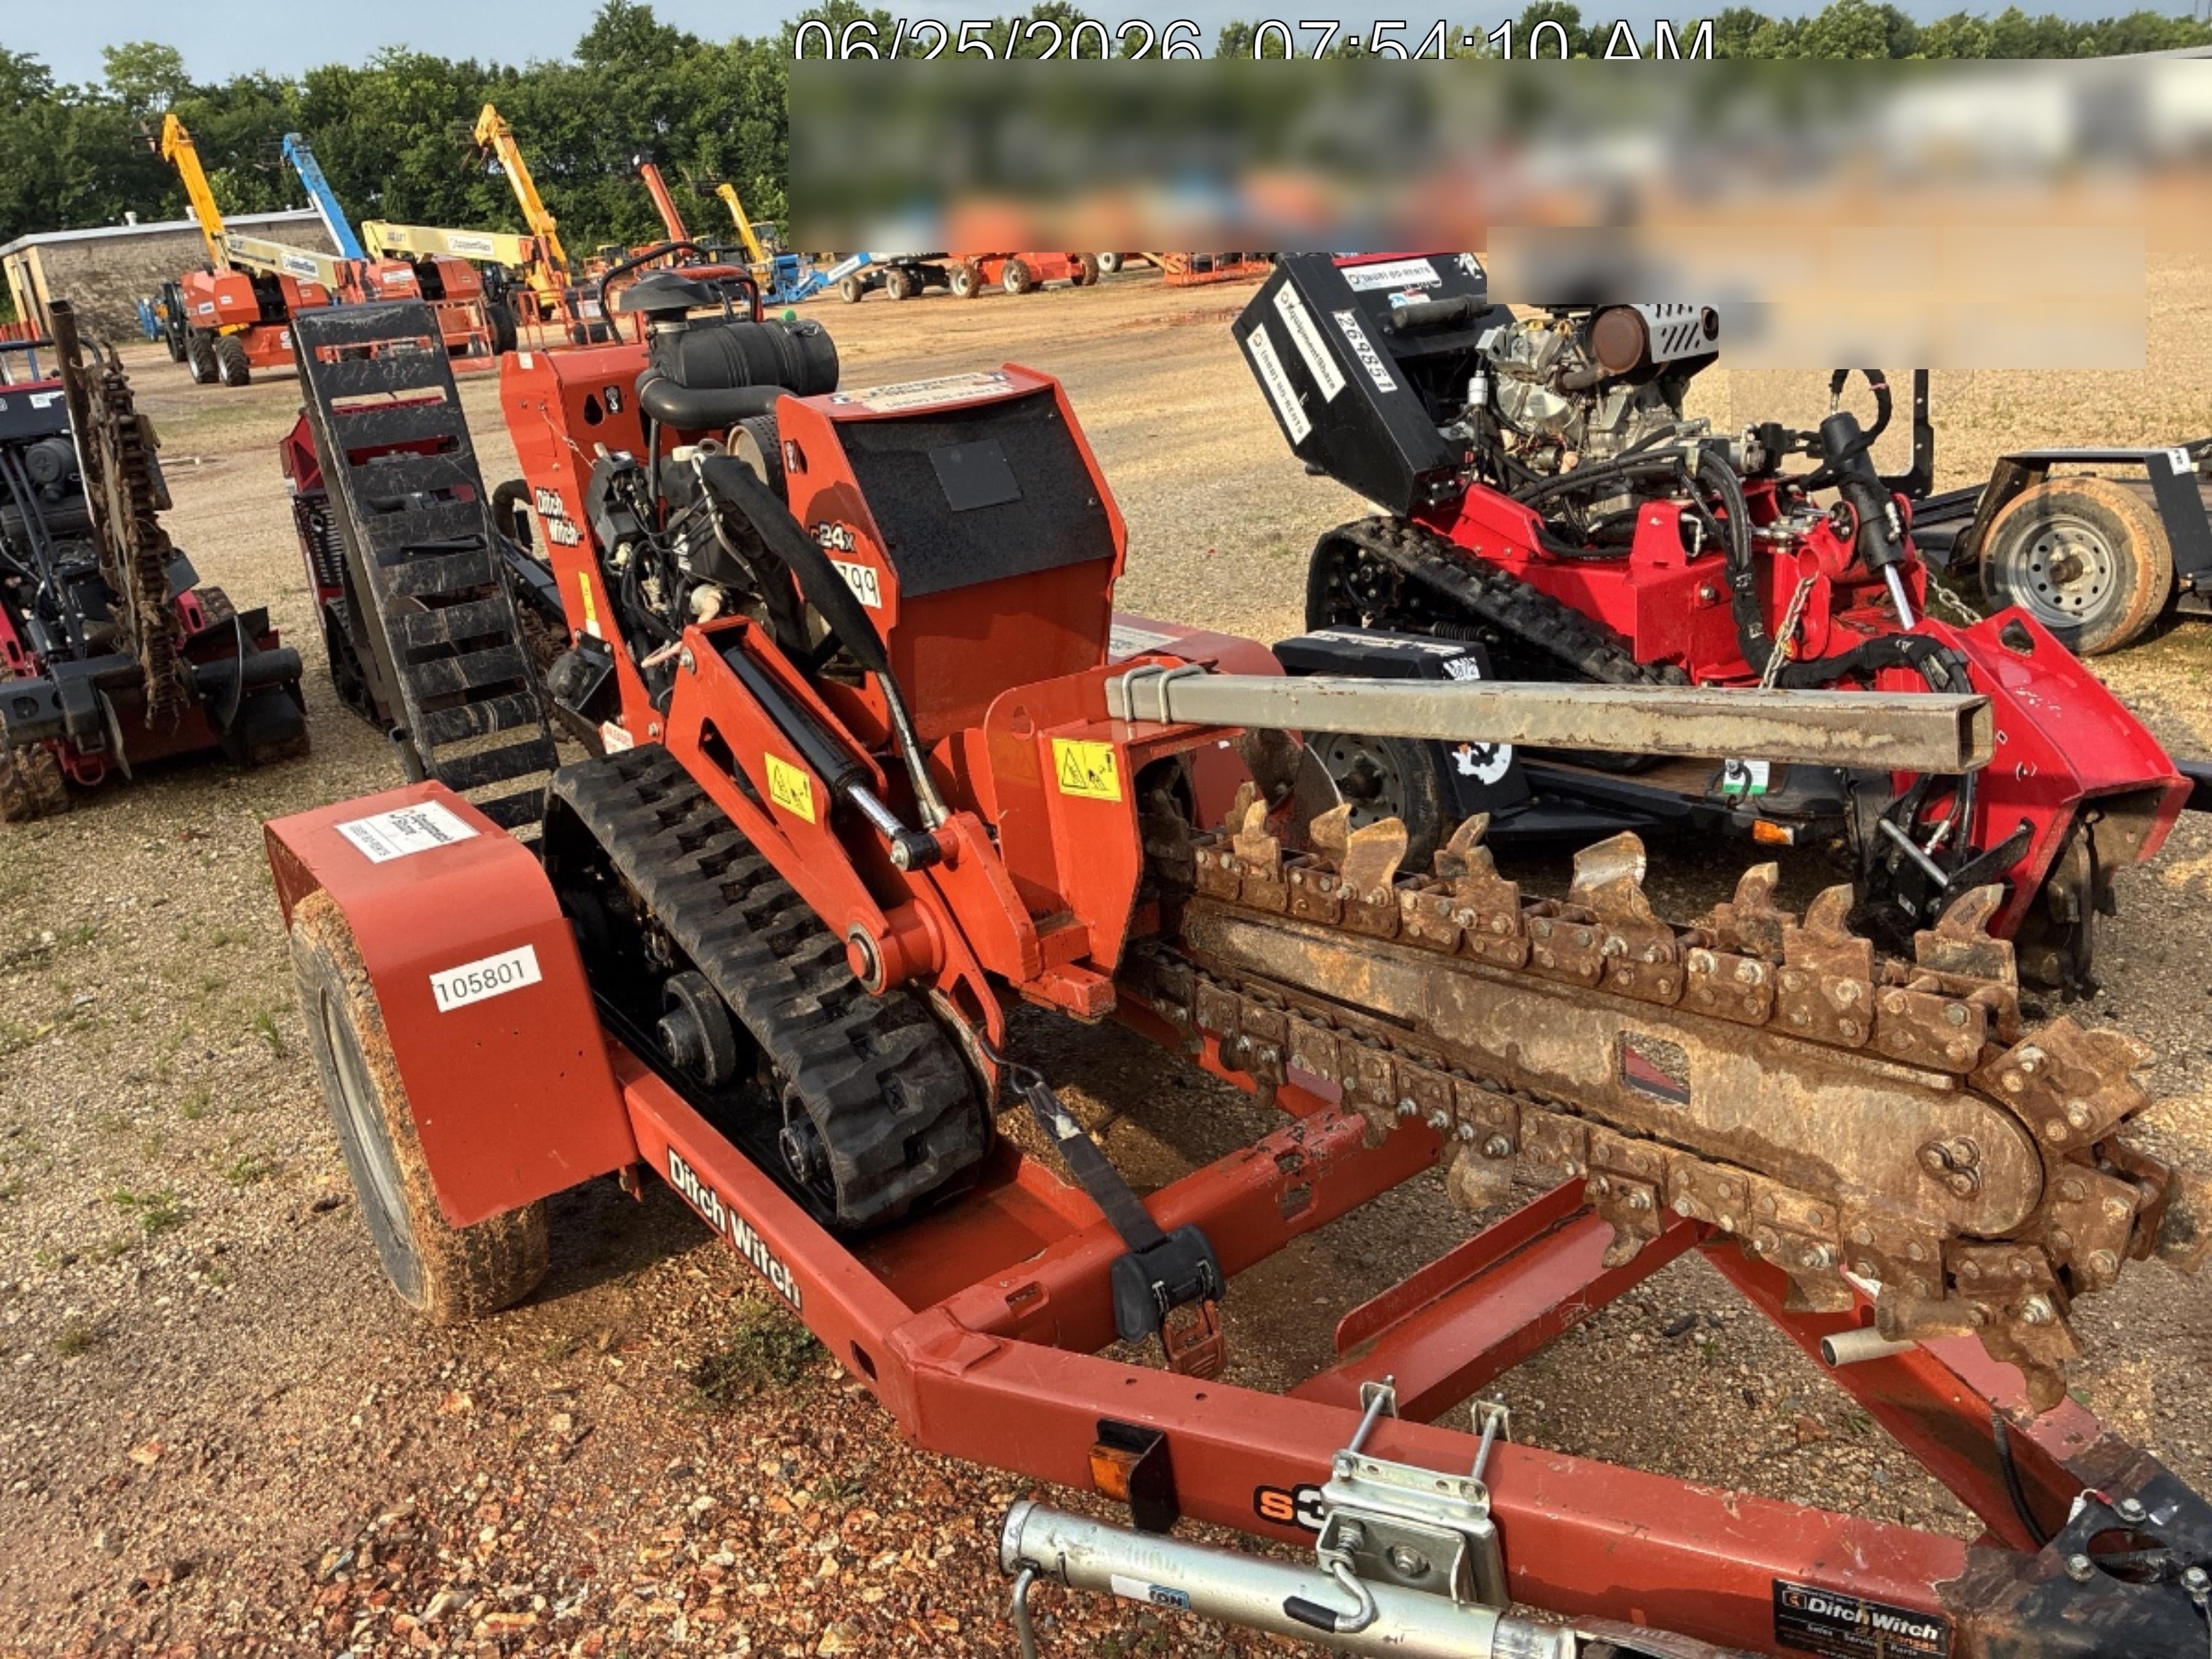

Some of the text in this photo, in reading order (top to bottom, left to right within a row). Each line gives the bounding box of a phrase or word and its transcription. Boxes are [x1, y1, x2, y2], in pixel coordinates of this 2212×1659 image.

[1337, 312, 1394, 388] 269851
[535, 488, 564, 515] Ditch
[547, 517, 578, 546] Witch
[437, 960, 524, 1002] 105801
[668, 1147, 801, 1310] Ditch Witch
[1808, 1596, 1870, 1625] Ditch
[1872, 1612, 1938, 1640] Witch
